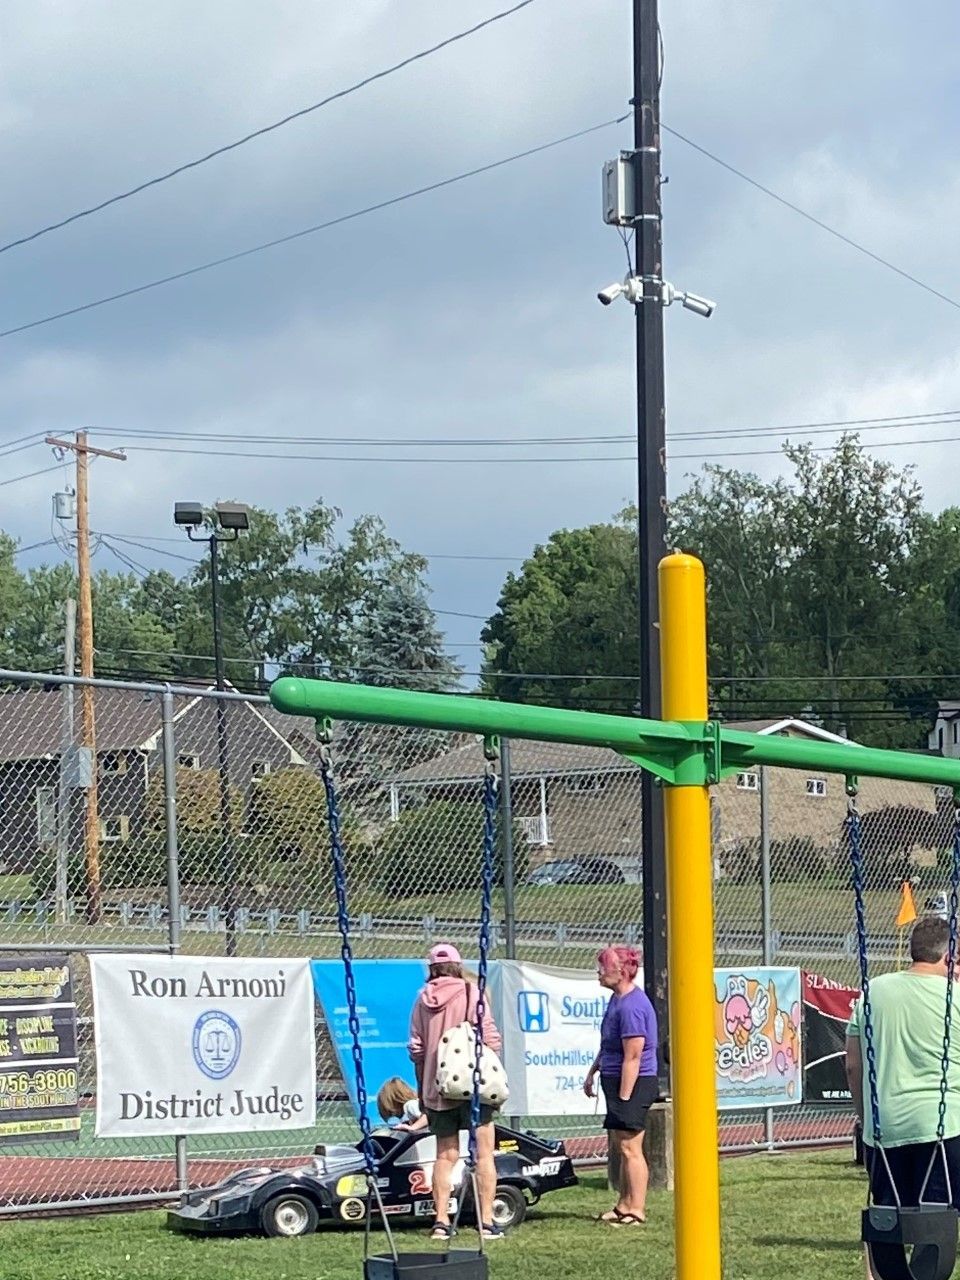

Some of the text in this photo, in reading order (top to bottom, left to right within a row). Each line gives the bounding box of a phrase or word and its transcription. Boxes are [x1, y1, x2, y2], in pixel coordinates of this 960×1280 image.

[128, 969, 287, 999] Ron Arnoni
[119, 1085, 305, 1121] District Judge
